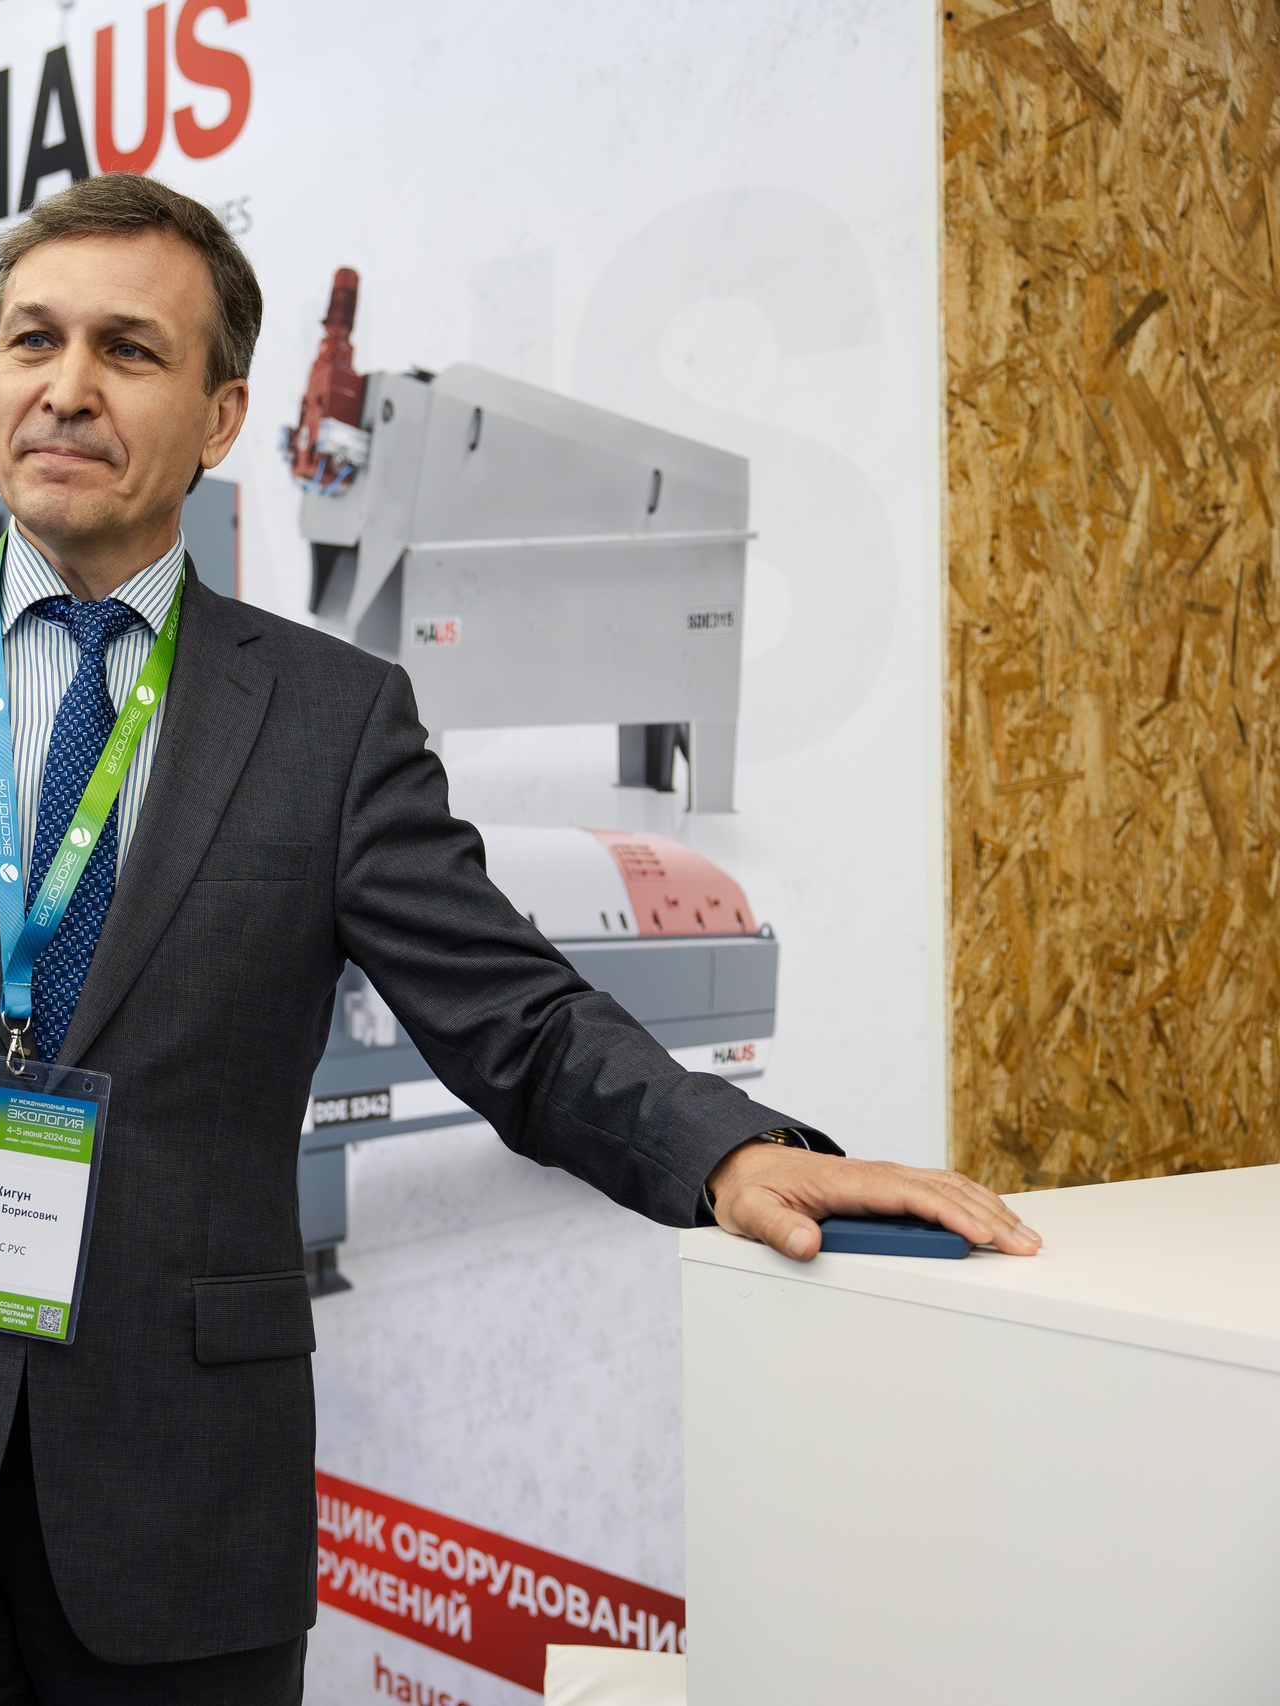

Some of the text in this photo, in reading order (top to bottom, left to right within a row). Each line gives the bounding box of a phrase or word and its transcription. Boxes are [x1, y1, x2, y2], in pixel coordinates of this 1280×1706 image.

[105, 707, 140, 775] ЭКОЛОГИЯ
[36, 850, 77, 927] ЭКОЛОГИЯ
[713, 1043, 756, 1065] HAUS
[18, 1099, 65, 1111] МЕЖДУНАРОДНЫЙ
[66, 1107, 85, 1115] ФОРУМ
[7, 1108, 84, 1130] ЭКОЛОГИЯ
[22, 1130, 43, 1139] июня
[43, 1131, 63, 1142] 2024
[64, 1137, 81, 1146] года
[1, 1204, 58, 1222] Борисович
[7, 1243, 27, 1256] РУС
[0, 1300, 25, 1311] ССЫЛКА
[2, 1316, 27, 1327] ФОРУМА
